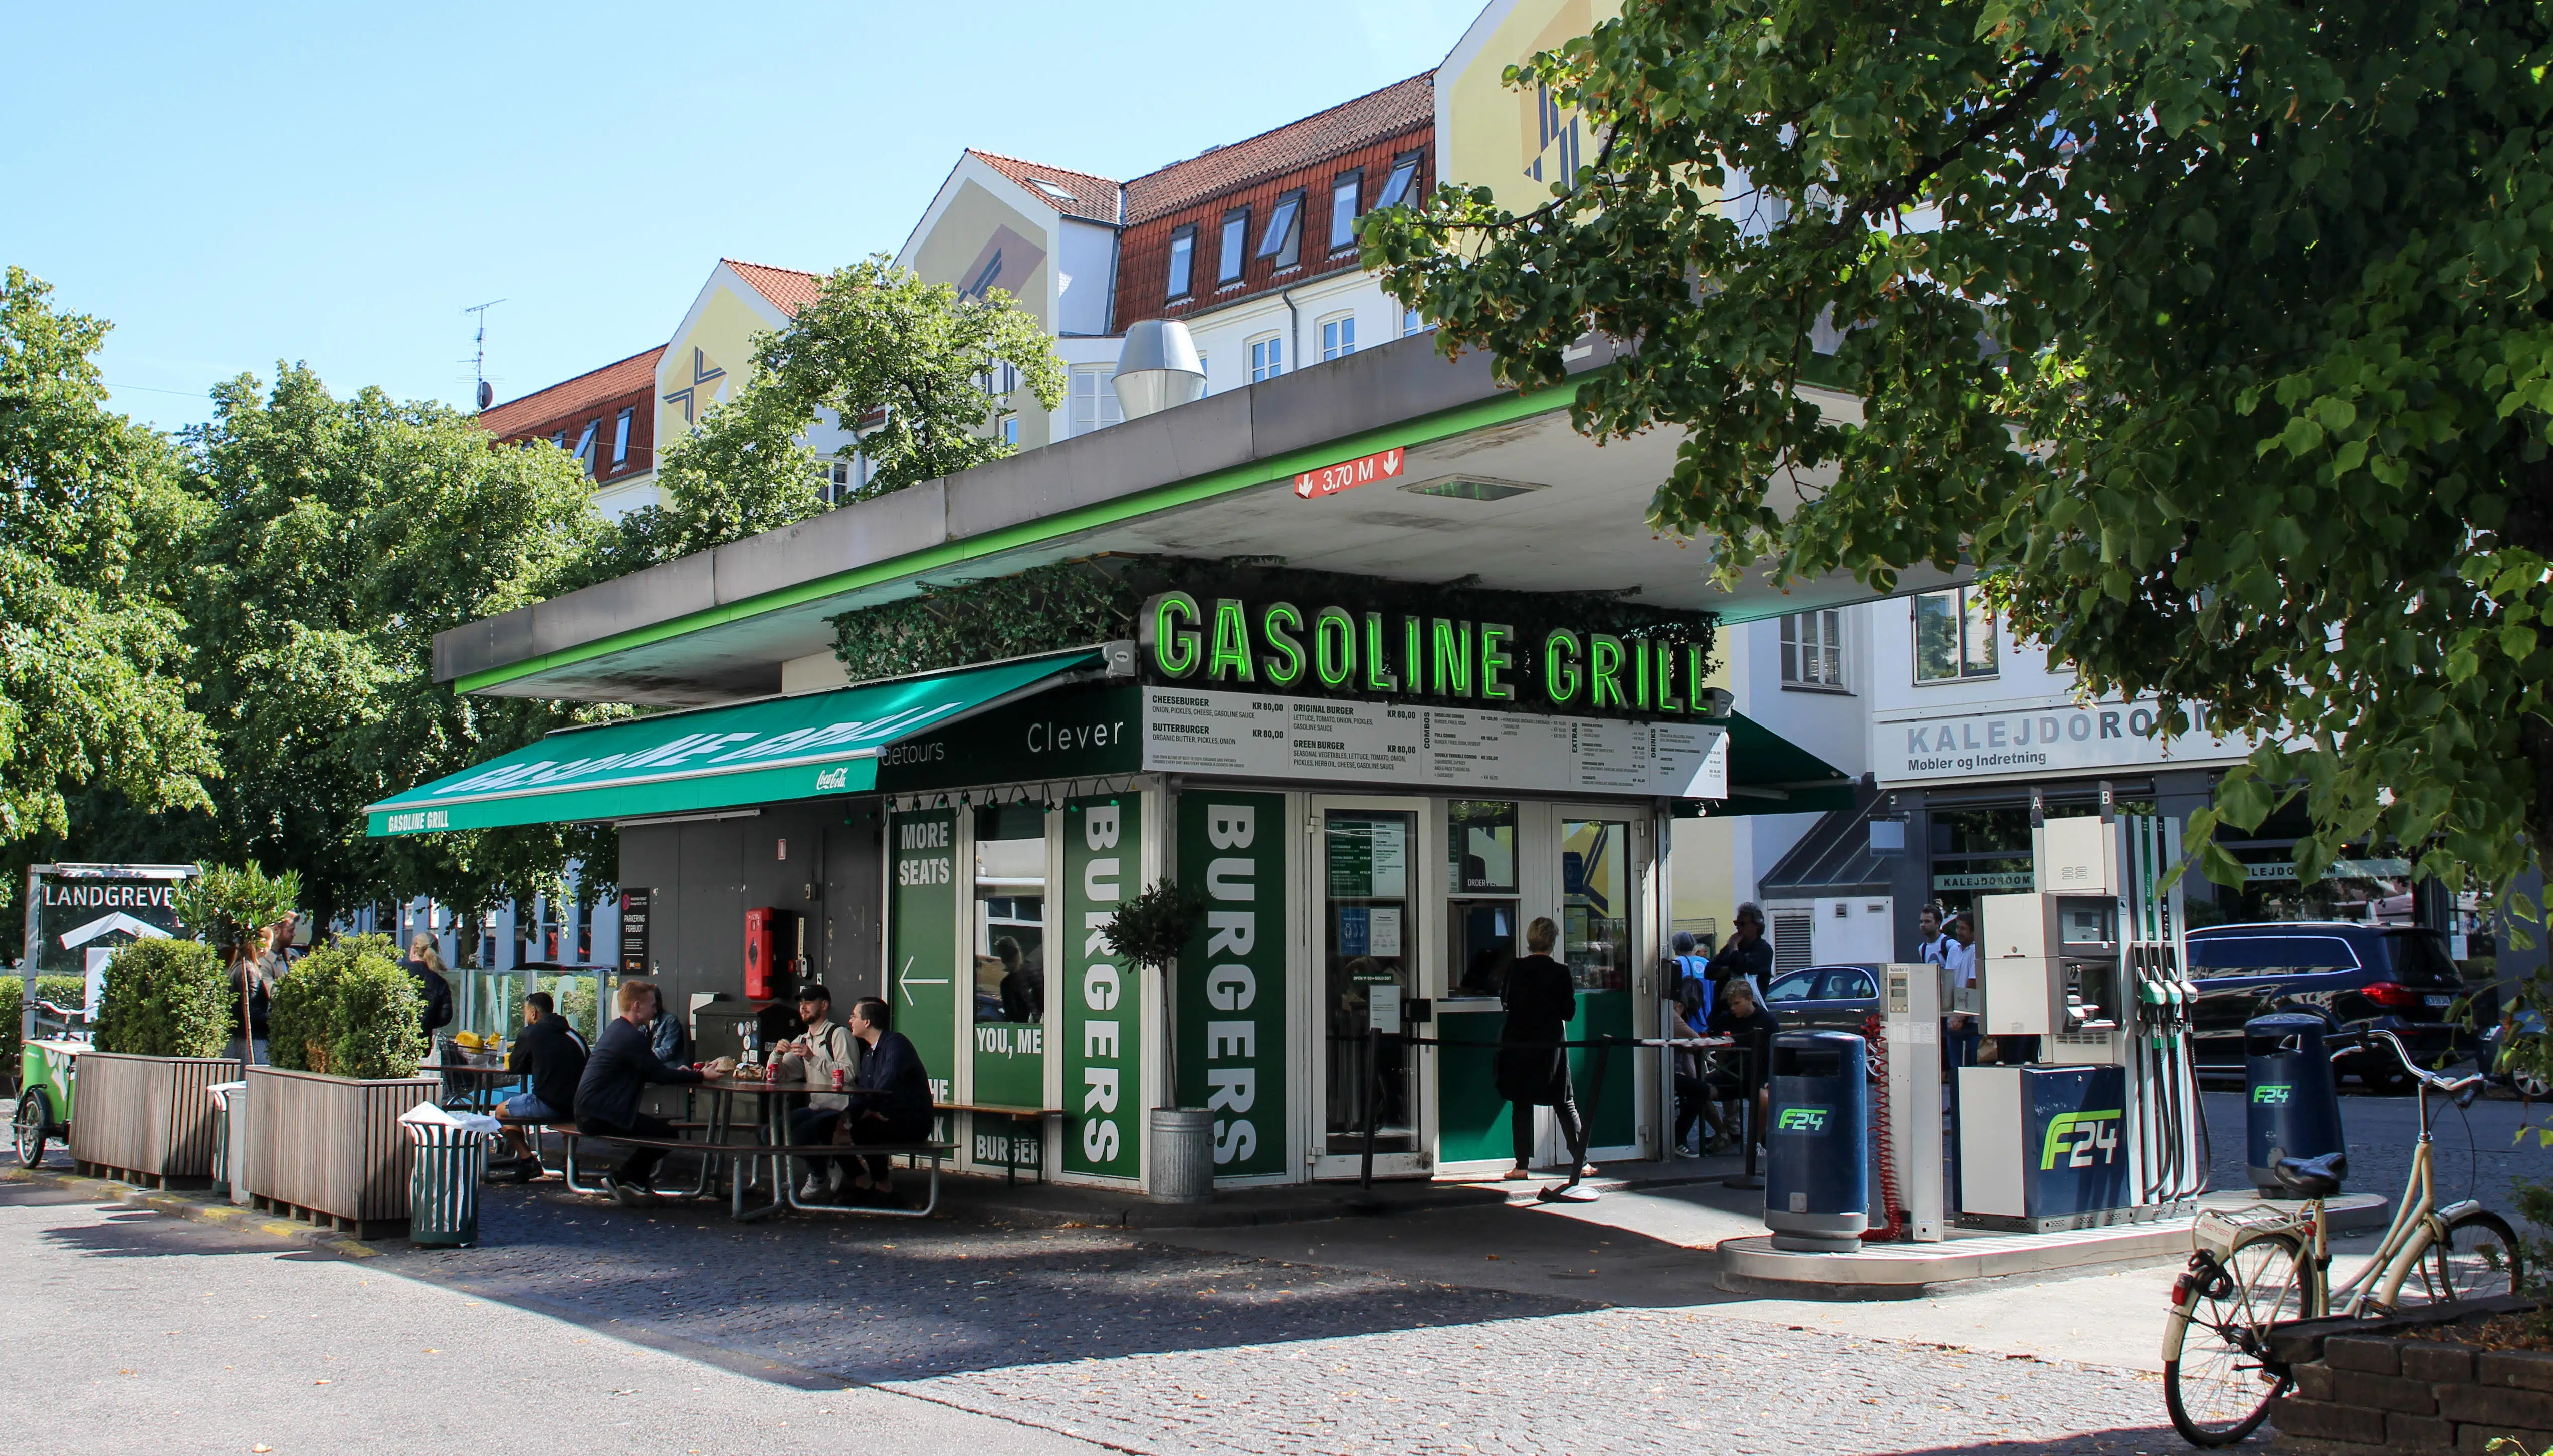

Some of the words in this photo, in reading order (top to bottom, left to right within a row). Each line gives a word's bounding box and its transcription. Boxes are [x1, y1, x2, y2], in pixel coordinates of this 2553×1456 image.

[1323, 465, 1352, 491] 3.70
[1358, 458, 1374, 482] M
[1152, 591, 1514, 701] GASOLINE
[1545, 628, 1715, 714] GRILL
[1153, 695, 1209, 706] CHEESEBURGER
[1252, 702, 1261, 710] KR
[1263, 703, 1283, 712] 80,00
[1193, 708, 1213, 716] CHEESE,
[1293, 703, 1325, 713] ORIGINAL
[1327, 706, 1353, 715] BURGER
[1387, 710, 1396, 718] KR
[1397, 711, 1415, 720] 80,00
[1028, 721, 1123, 753] Clever
[1153, 723, 1209, 734] BUTTERBURGER
[1253, 729, 1261, 737] KR
[1263, 730, 1283, 739] 80,00
[1908, 704, 2208, 754] KALEJDORO
[432, 732, 761, 795] GASOLINE
[708, 702, 963, 763] GRILL
[882, 740, 944, 766] detours
[1293, 740, 1316, 748] GREEN
[1317, 741, 1344, 750] BURGER
[1397, 746, 1415, 754] 80,00
[1908, 756, 1953, 771] Møbler
[1958, 757, 1973, 770] og
[1976, 751, 2046, 766] Indretning
[2032, 797, 2041, 809] A
[2102, 791, 2110, 804] B
[388, 812, 425, 832] GASOLINE
[427, 810, 449, 830] GRILL
[902, 821, 948, 850] MORE
[899, 857, 949, 886] SEATS
[1944, 875, 2030, 886] KALEJDOROOM
[45, 886, 175, 906] LANDGREVE
[1084, 806, 1120, 1163] BURGERS
[1206, 805, 1256, 1164] BURGERS
[976, 1027, 1013, 1059] YOU,
[1017, 1028, 1041, 1054] ME
[2254, 1085, 2291, 1103] F24
[1779, 1109, 1827, 1131] F24
[2041, 1109, 2121, 1170] F24
